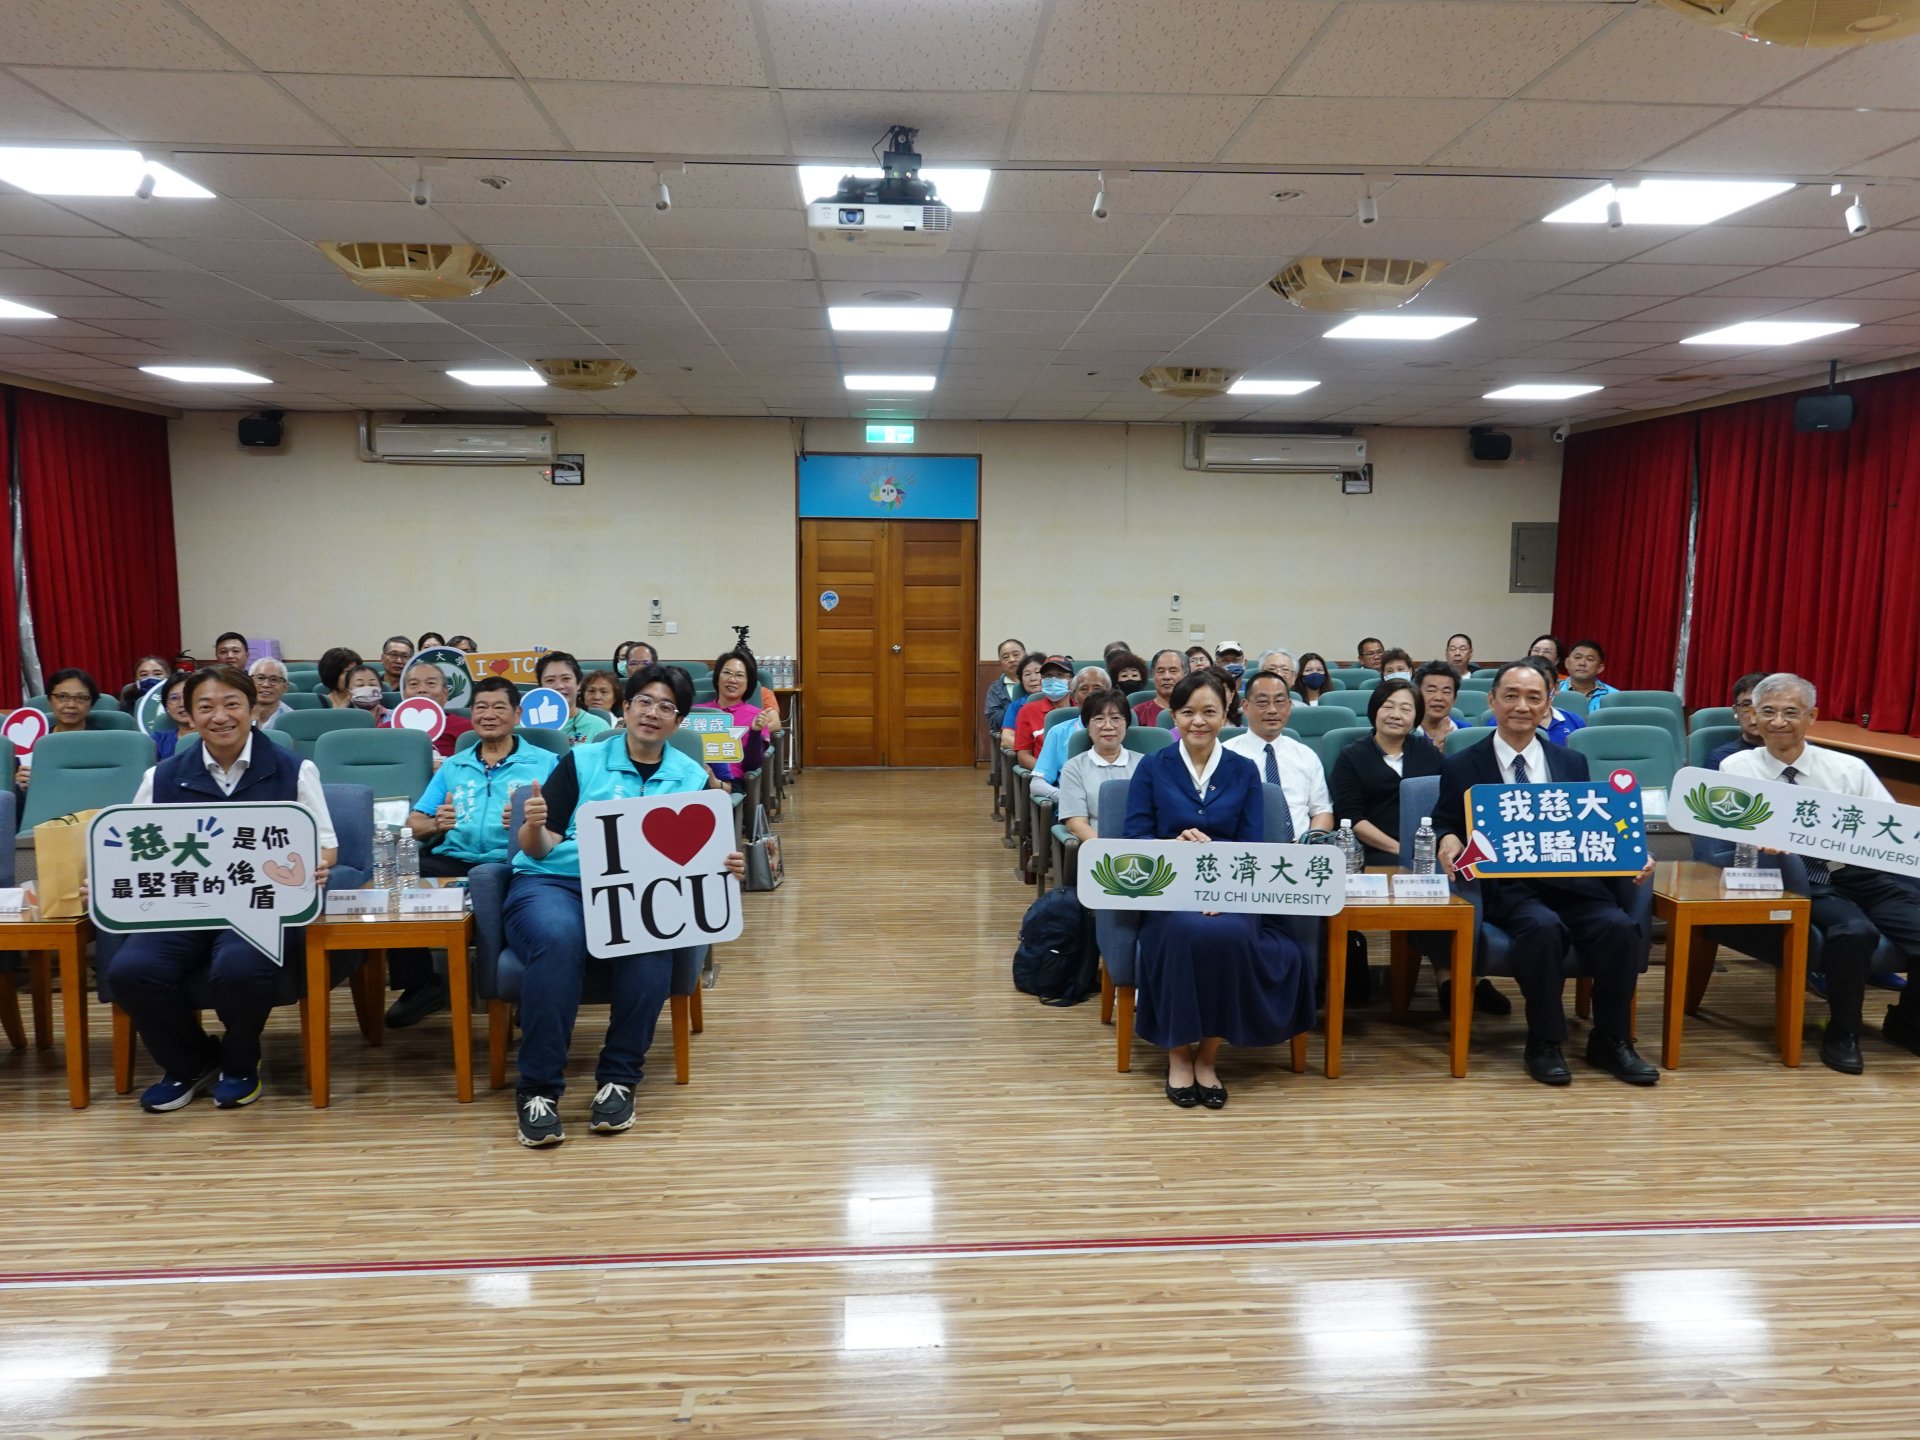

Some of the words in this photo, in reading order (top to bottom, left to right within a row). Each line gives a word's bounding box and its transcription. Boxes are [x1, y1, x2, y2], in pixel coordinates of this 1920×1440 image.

[476, 659, 487, 676] I
[511, 656, 539, 674] TC
[705, 742, 736, 757] 無畏
[1499, 789, 1612, 822] 我慈大
[1792, 799, 1920, 845] 慈濟大
[126, 823, 212, 868] 慈大
[232, 826, 290, 850] 是你
[595, 813, 629, 876] I
[1502, 830, 1617, 863] 我驕傲
[1788, 832, 1816, 846] TZU
[1820, 838, 1846, 852] CHI
[1194, 852, 1333, 888] 慈濟大學
[591, 871, 731, 946] TCU
[1194, 890, 1220, 902] TZU
[1224, 891, 1247, 902] CHI
[1252, 892, 1331, 905] UNIVERSITY
